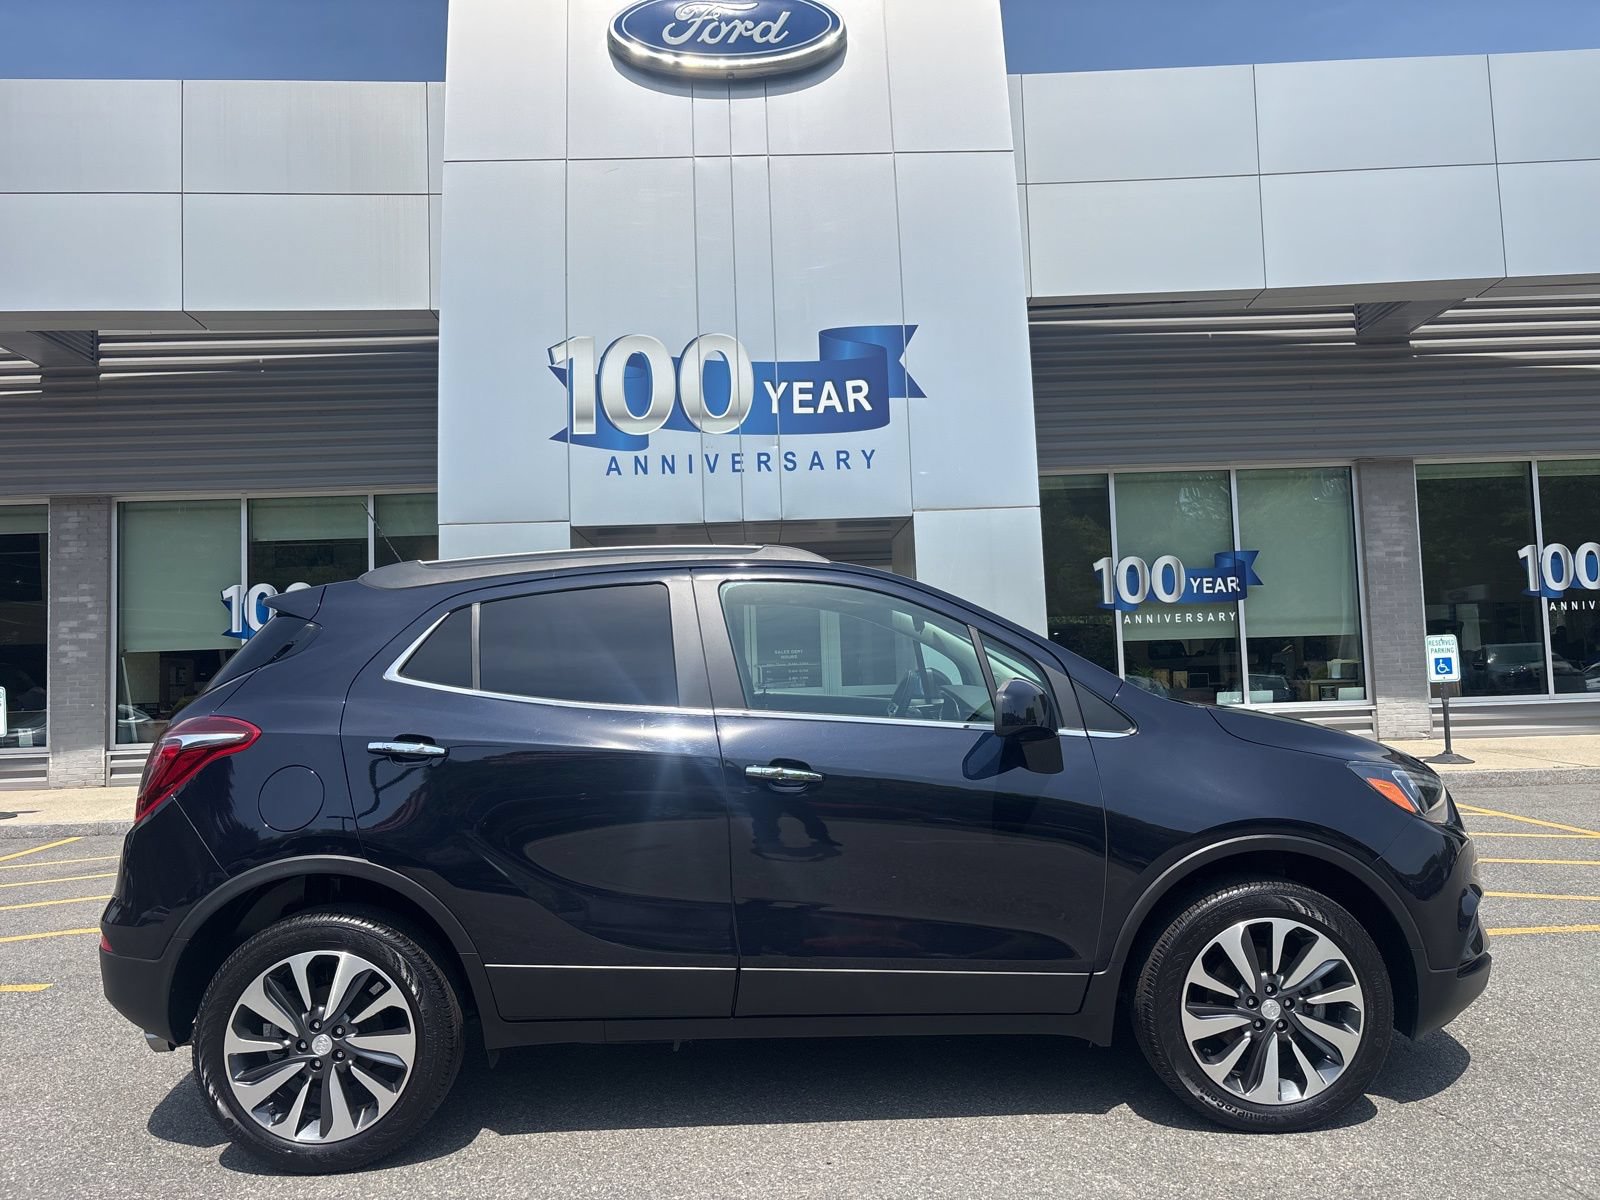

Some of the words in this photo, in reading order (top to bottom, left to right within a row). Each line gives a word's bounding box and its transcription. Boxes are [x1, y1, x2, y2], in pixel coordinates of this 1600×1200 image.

[662, 2, 791, 46] Ford
[548, 333, 755, 436] 100
[763, 379, 873, 415] YEAR
[606, 449, 876, 476] ANNIVERSARY
[1093, 554, 1186, 604] 100
[1190, 576, 1241, 594] YEAR
[1517, 541, 1600, 592] 100
[221, 582, 312, 633] 10
[1124, 612, 1236, 625] ANNIVERSARY
[1428, 639, 1455, 647] RESERVED
[1431, 647, 1455, 655] PARKING
